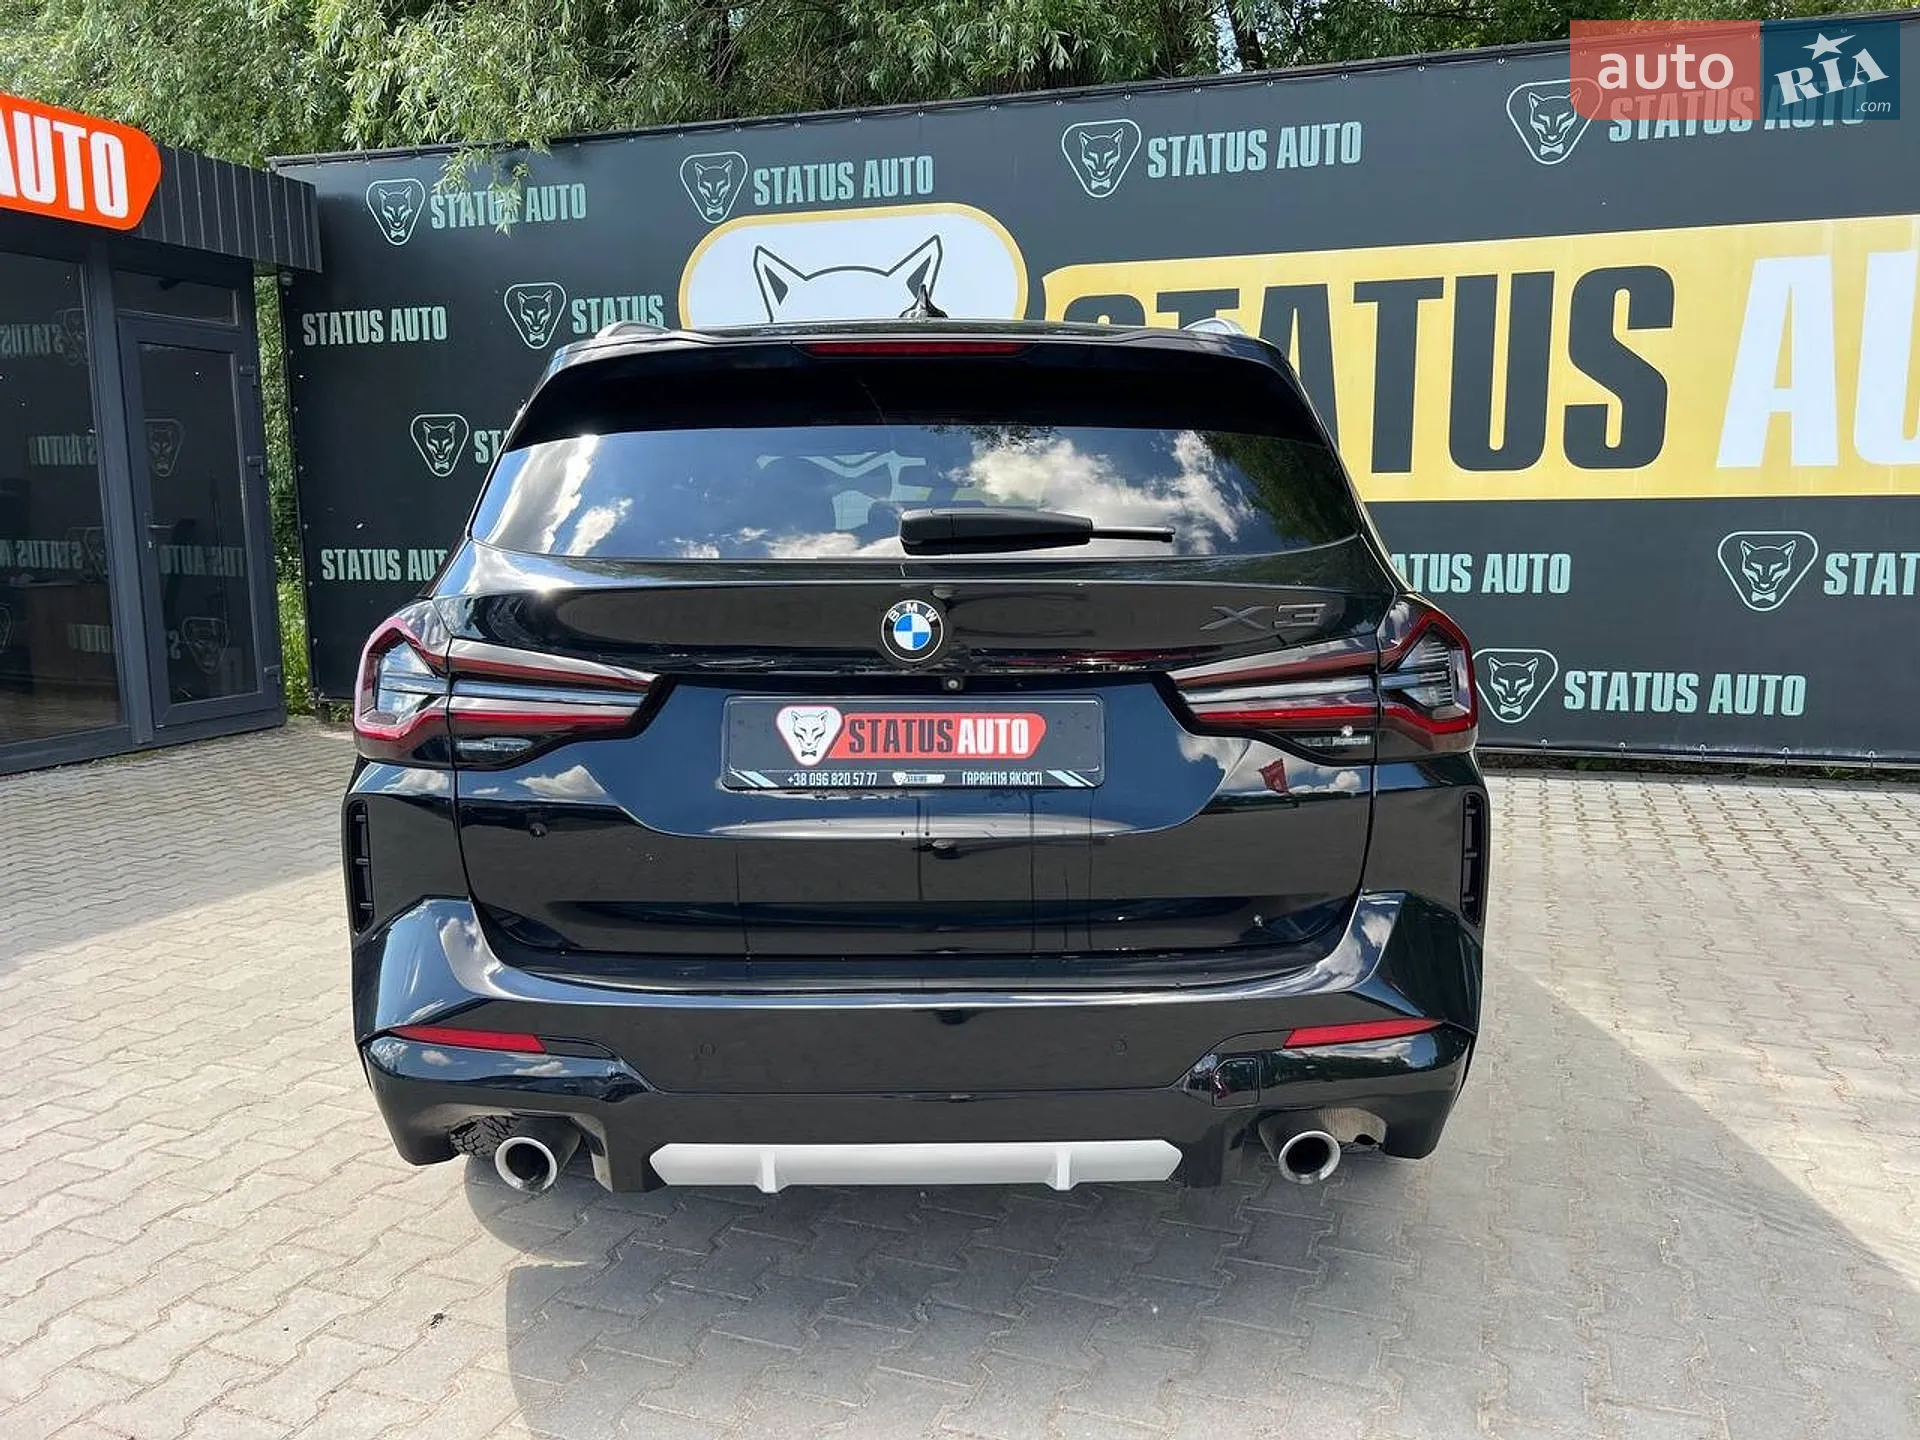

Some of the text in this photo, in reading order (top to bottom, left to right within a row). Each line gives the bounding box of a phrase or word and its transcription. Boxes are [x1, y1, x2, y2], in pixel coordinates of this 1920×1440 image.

[1608, 86, 1753, 143] STATUS
[1148, 121, 1362, 179] STATUS AUTO
[753, 155, 934, 206] STATUS AUTO
[430, 183, 587, 230] STATU AUTO
[302, 305, 448, 346] STATUS AUTO
[1063, 265, 1676, 473] ATUS
[321, 548, 402, 581] STATUS
[1481, 553, 1572, 594] AUTO
[888, 602, 939, 623] BMW
[1199, 603, 1327, 631] X3
[1564, 670, 1807, 716] STATUS AUTO
[849, 718, 1029, 755] STATUS AUTO
[787, 772, 807, 786] +38
[809, 772, 829, 786] 096
[831, 772, 850, 786] 820
